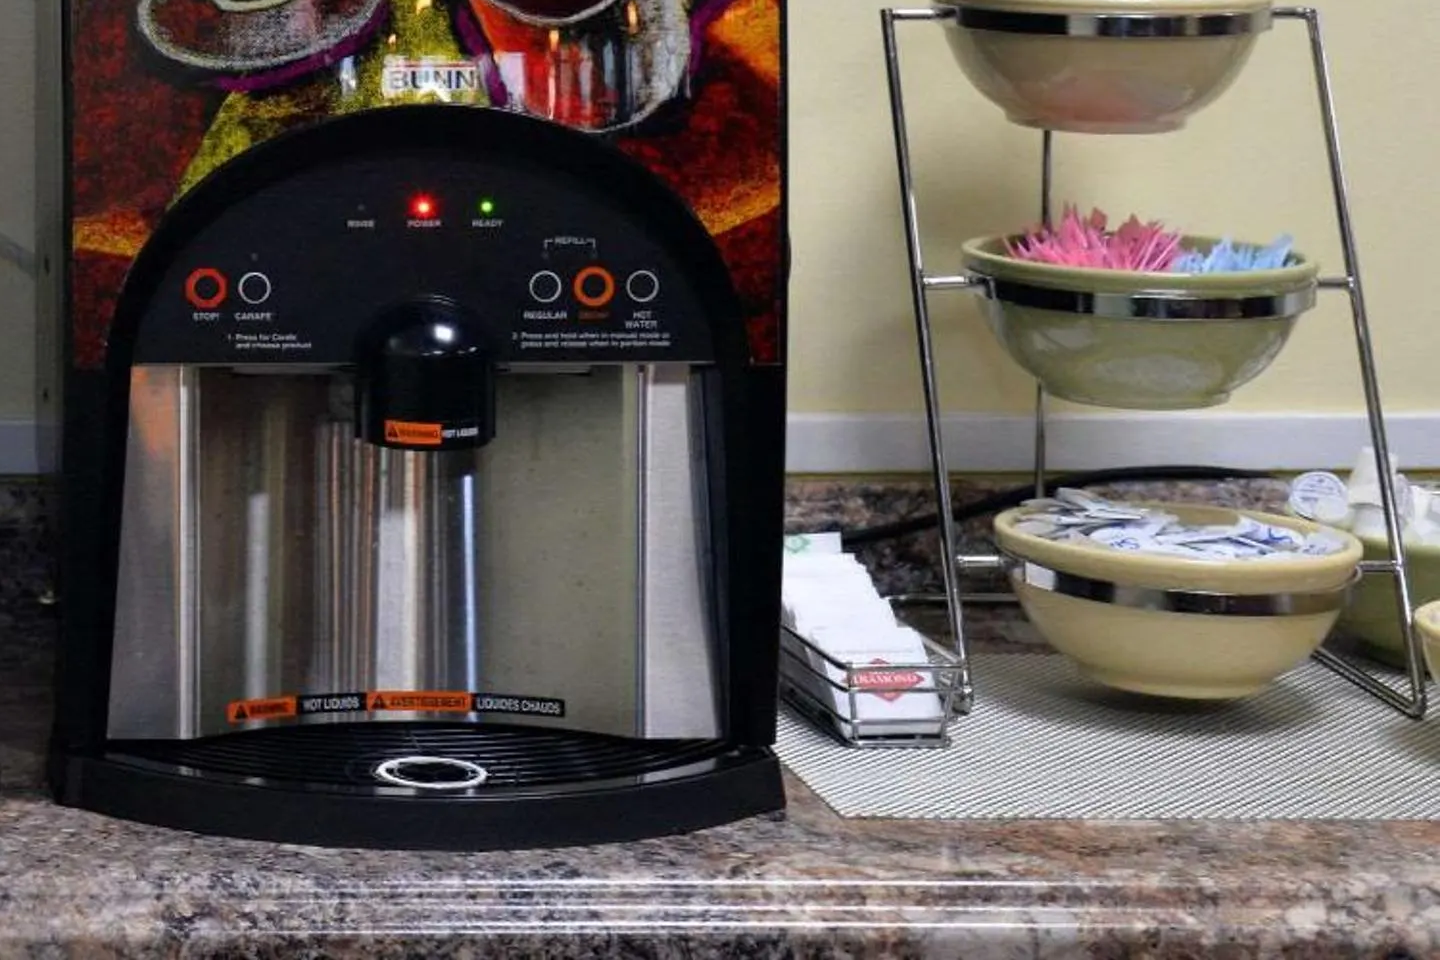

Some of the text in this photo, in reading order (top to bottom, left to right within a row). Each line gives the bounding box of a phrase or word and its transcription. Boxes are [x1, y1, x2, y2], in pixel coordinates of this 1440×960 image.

[388, 69, 474, 90] BUNN
[407, 219, 441, 228] POWER
[472, 218, 503, 228] READY
[554, 236, 586, 245] REFILL
[234, 311, 272, 321] CARAFE
[523, 310, 568, 320] REGULAR
[633, 310, 652, 319] HOT
[625, 320, 657, 329] WATER
[303, 699, 323, 710] HOT
[323, 697, 360, 709] LIQUIDS
[477, 698, 520, 711] LIQUIDES
[521, 700, 560, 715] CHAUDS
